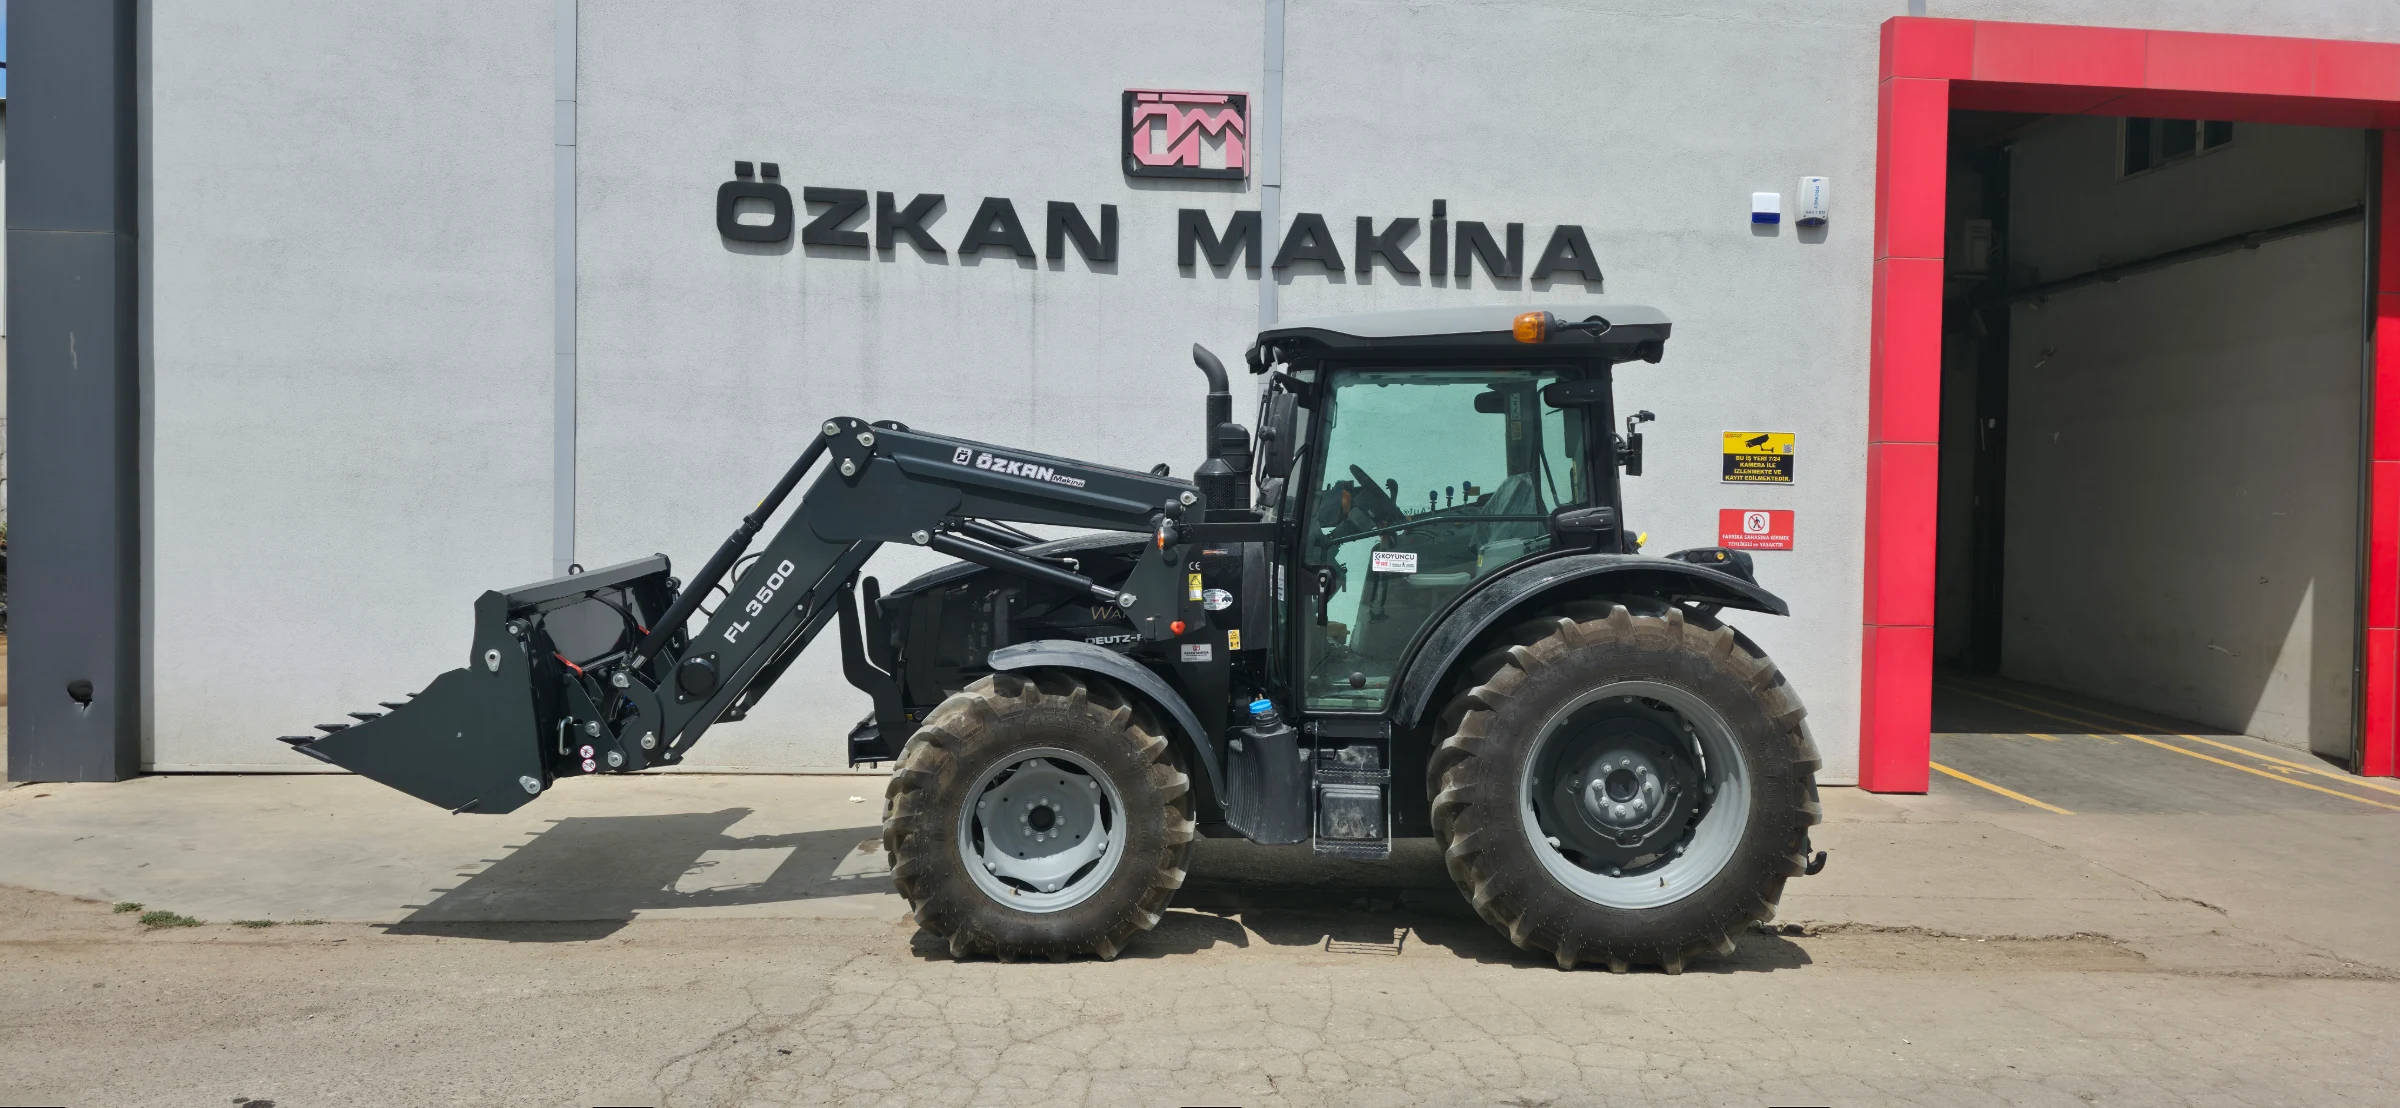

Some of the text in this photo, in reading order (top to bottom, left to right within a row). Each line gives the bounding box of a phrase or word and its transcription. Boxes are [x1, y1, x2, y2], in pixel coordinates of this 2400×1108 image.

[717, 161, 1604, 282] ÖZKAN MAKİNA
[975, 453, 1085, 487] ÖZKAN Makina
[723, 559, 795, 644] FL 3500
